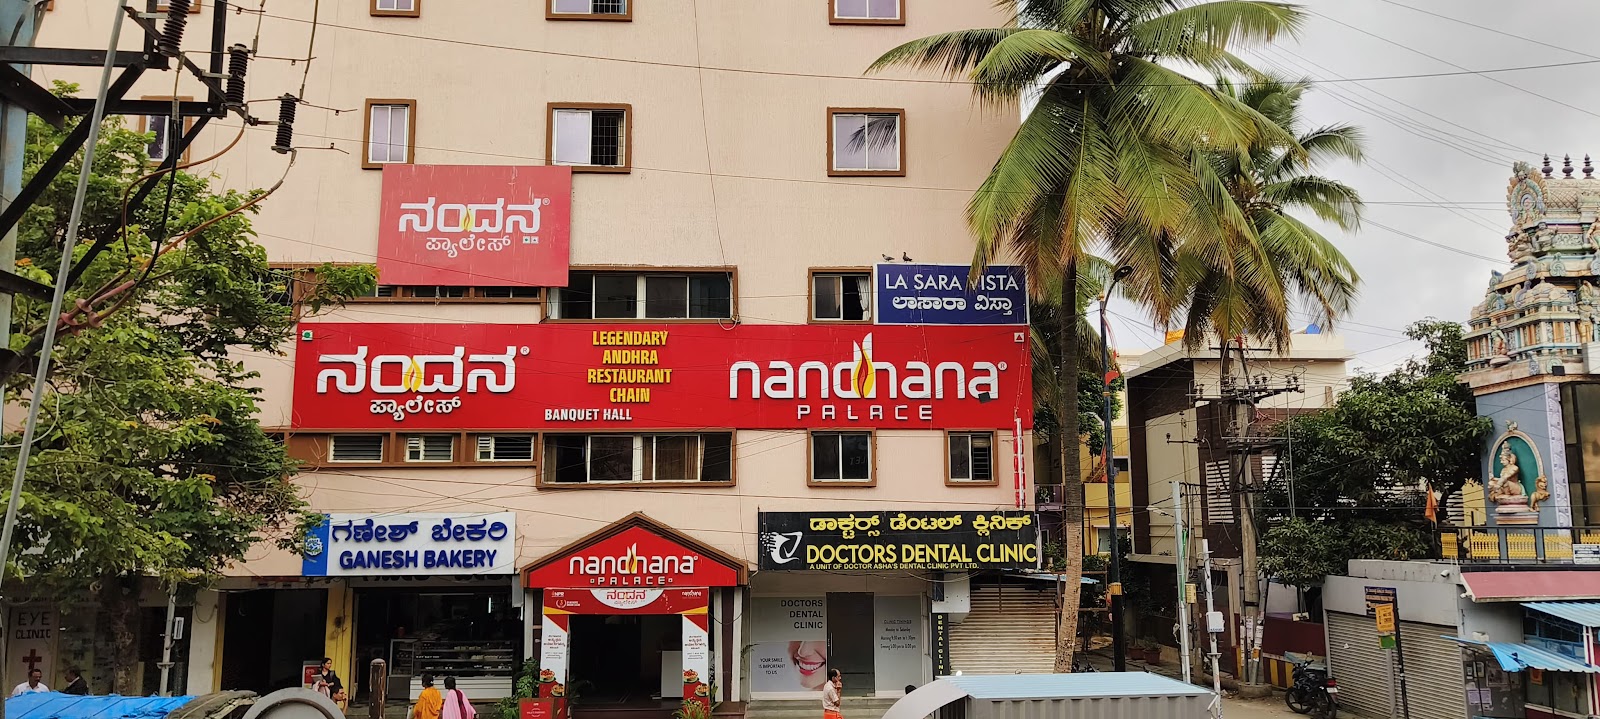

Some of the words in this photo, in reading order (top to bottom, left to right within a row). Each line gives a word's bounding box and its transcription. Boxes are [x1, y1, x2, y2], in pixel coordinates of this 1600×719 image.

[398, 197, 542, 233] ನಂದನ
[885, 273, 908, 290] LA
[914, 274, 962, 291] SARA
[592, 330, 669, 346] LEGENDARY
[602, 350, 659, 365] ANDHRA
[316, 346, 518, 393] ನಂದನ
[729, 332, 999, 400] nandhana
[587, 369, 673, 384] RESTAURANT
[609, 387, 651, 403] CHAIN
[544, 408, 600, 422] BANQUET
[603, 408, 633, 421] HALL
[797, 404, 933, 421] PALACE
[331, 519, 419, 542] ಗಣೇಶ್
[431, 518, 508, 542] ಬೇಕರಿ
[339, 550, 418, 570] GANESH
[423, 549, 498, 569] BAKERY
[569, 543, 695, 575] nandhana
[806, 544, 897, 564] DOCTORS
[901, 544, 972, 563] DENTAL
[976, 543, 1037, 563] CLINIC
[927, 562, 949, 570] CLINIC
[597, 576, 666, 586] PALACE
[780, 599, 823, 607] DOCTORS
[18, 611, 51, 626] EYE
[789, 610, 824, 618] DENTAL
[793, 621, 823, 629] CLINIC
[15, 628, 51, 640] CLINIC
